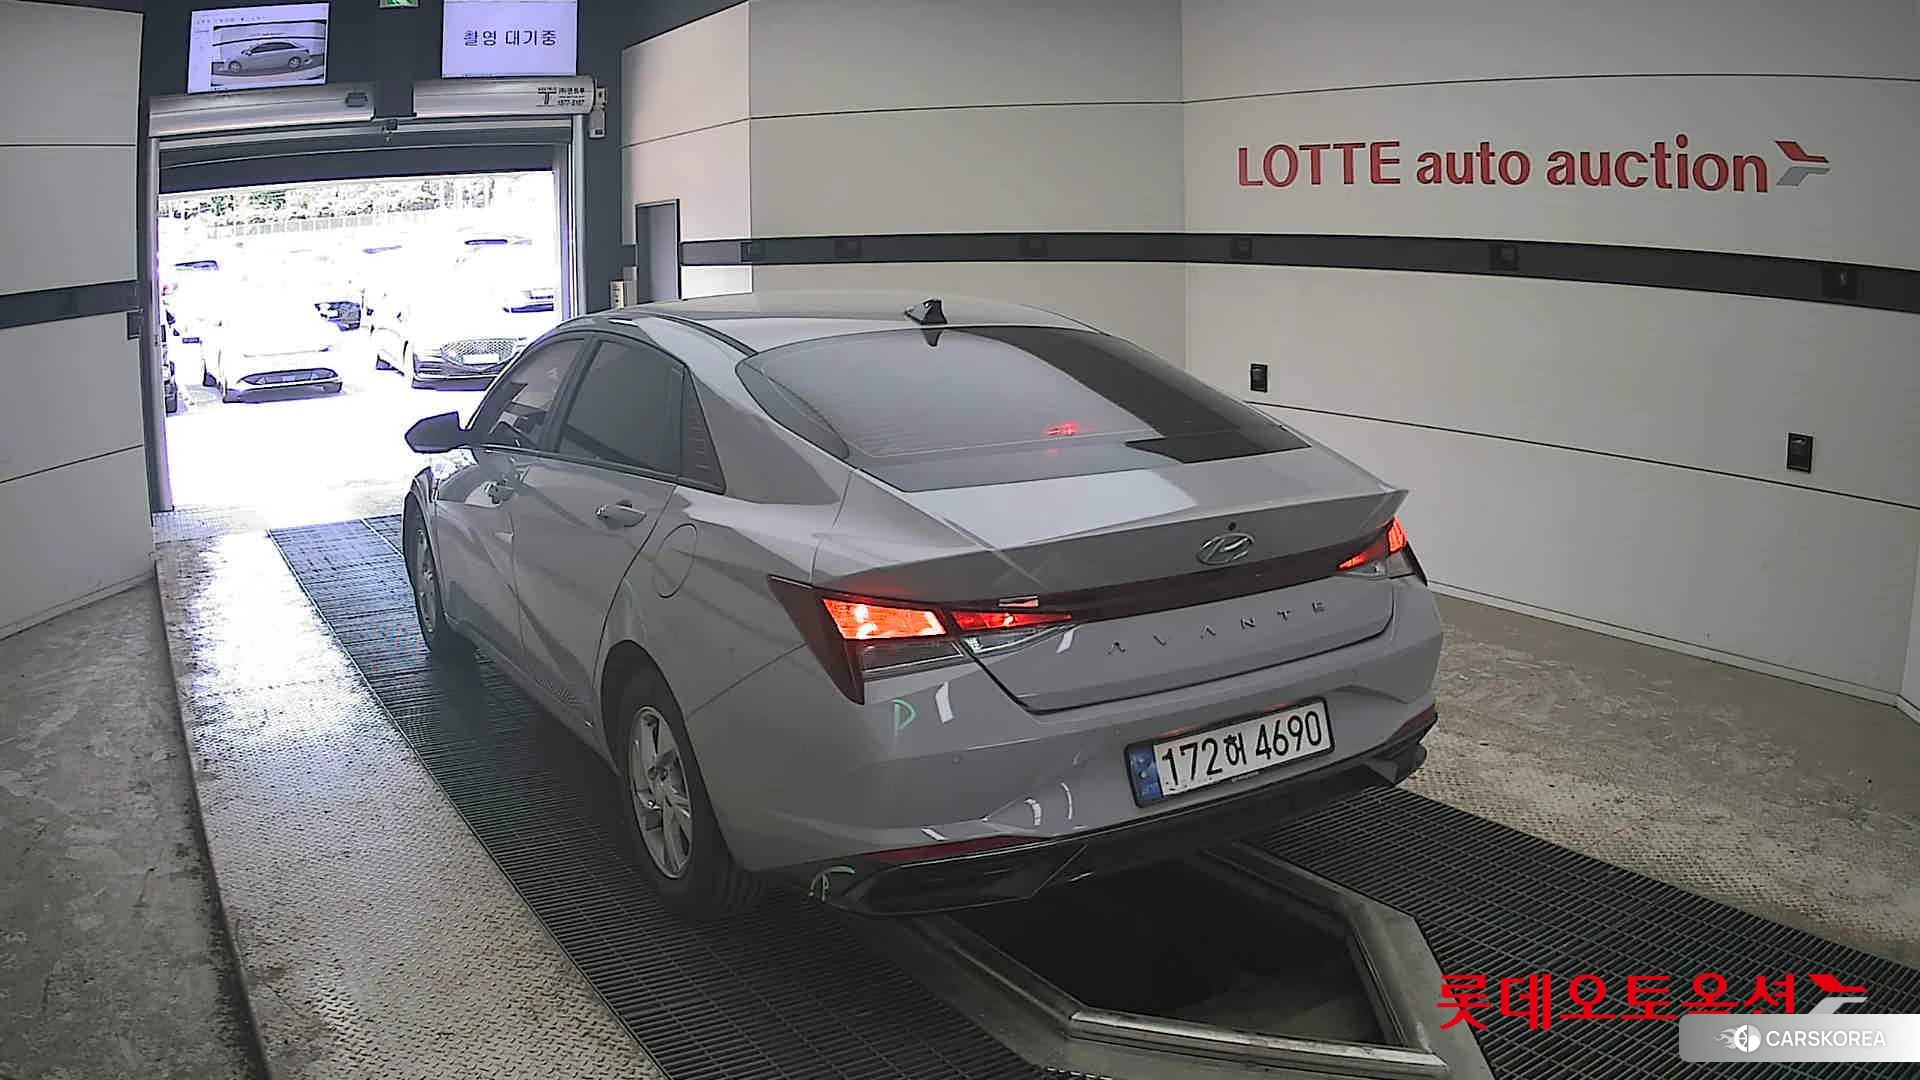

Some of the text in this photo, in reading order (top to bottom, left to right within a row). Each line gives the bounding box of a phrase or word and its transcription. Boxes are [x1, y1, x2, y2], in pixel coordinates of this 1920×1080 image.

[505, 30, 557, 47] 대기중
[1237, 133, 1768, 193] LOTTE auto auction
[1107, 599, 1327, 656] AVANTE
[1255, 711, 1322, 760] 4690
